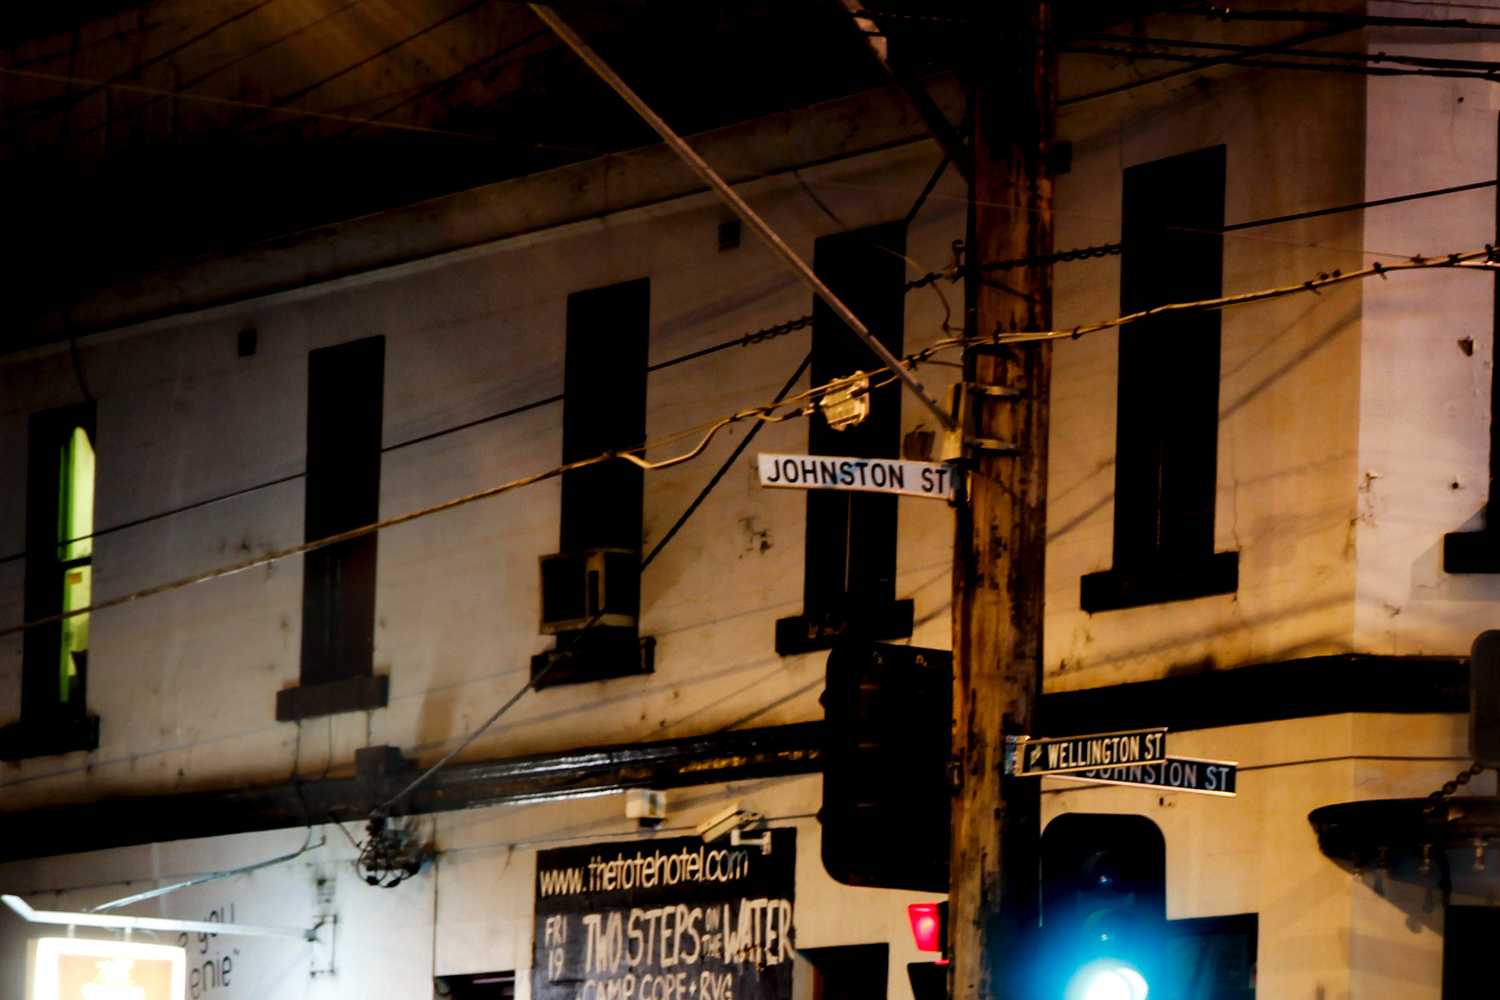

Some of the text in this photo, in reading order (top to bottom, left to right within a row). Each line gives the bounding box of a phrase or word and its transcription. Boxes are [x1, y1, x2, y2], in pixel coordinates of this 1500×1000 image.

[767, 458, 948, 494] JOHNSTON ST
[1048, 733, 1163, 769] WELLINGTON ST
[1205, 766, 1230, 791] ST
[540, 847, 749, 896] www.thetotehotel.com
[545, 914, 567, 946] FRI
[582, 912, 624, 973] TWO
[626, 904, 702, 969] STEPS
[723, 898, 795, 966] WATER
[549, 947, 563, 980] 19
